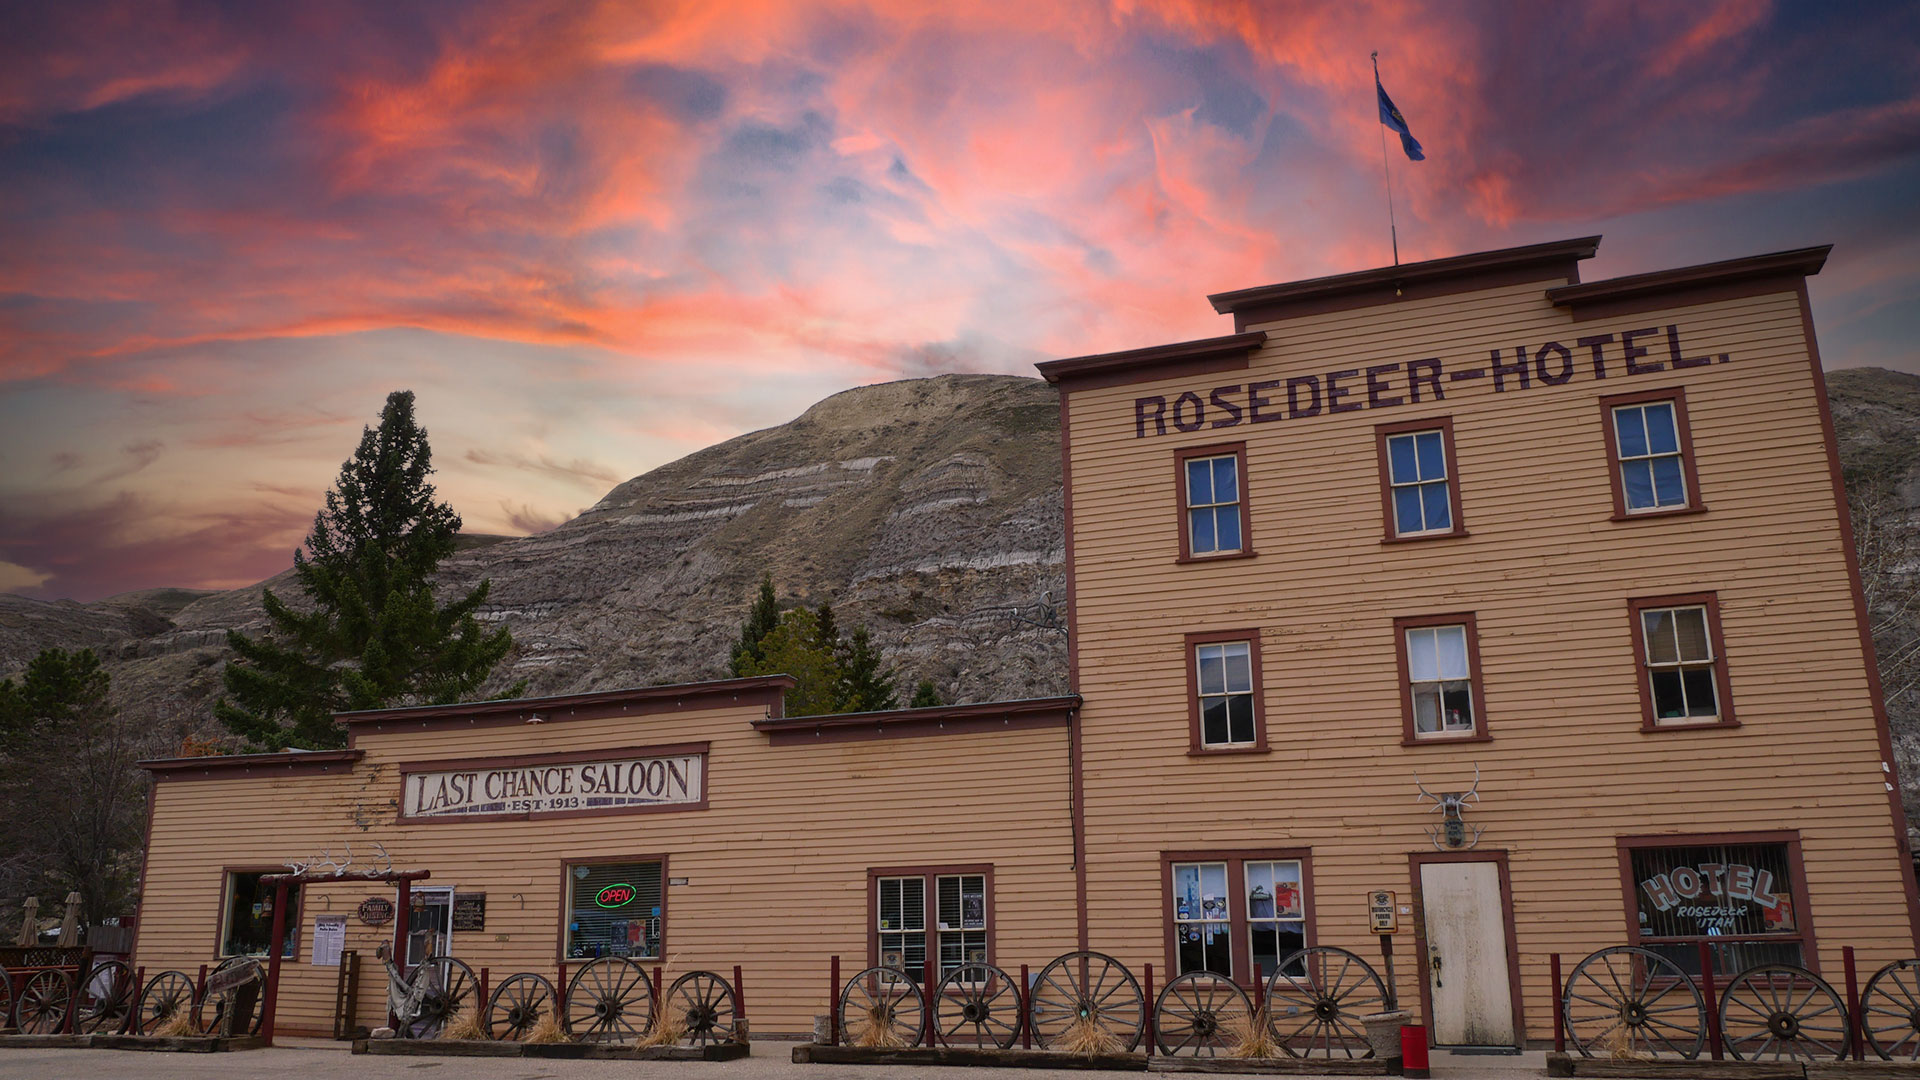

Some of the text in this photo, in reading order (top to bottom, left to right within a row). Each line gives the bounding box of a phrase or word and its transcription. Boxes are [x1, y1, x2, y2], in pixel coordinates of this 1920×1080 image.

[416, 758, 690, 813] LAST CHANCE SALOON
[550, 797, 579, 809] 1913
[1641, 863, 1778, 912] HOTEL
[600, 889, 631, 902] OPEN
[362, 904, 390, 912] FAMILY
